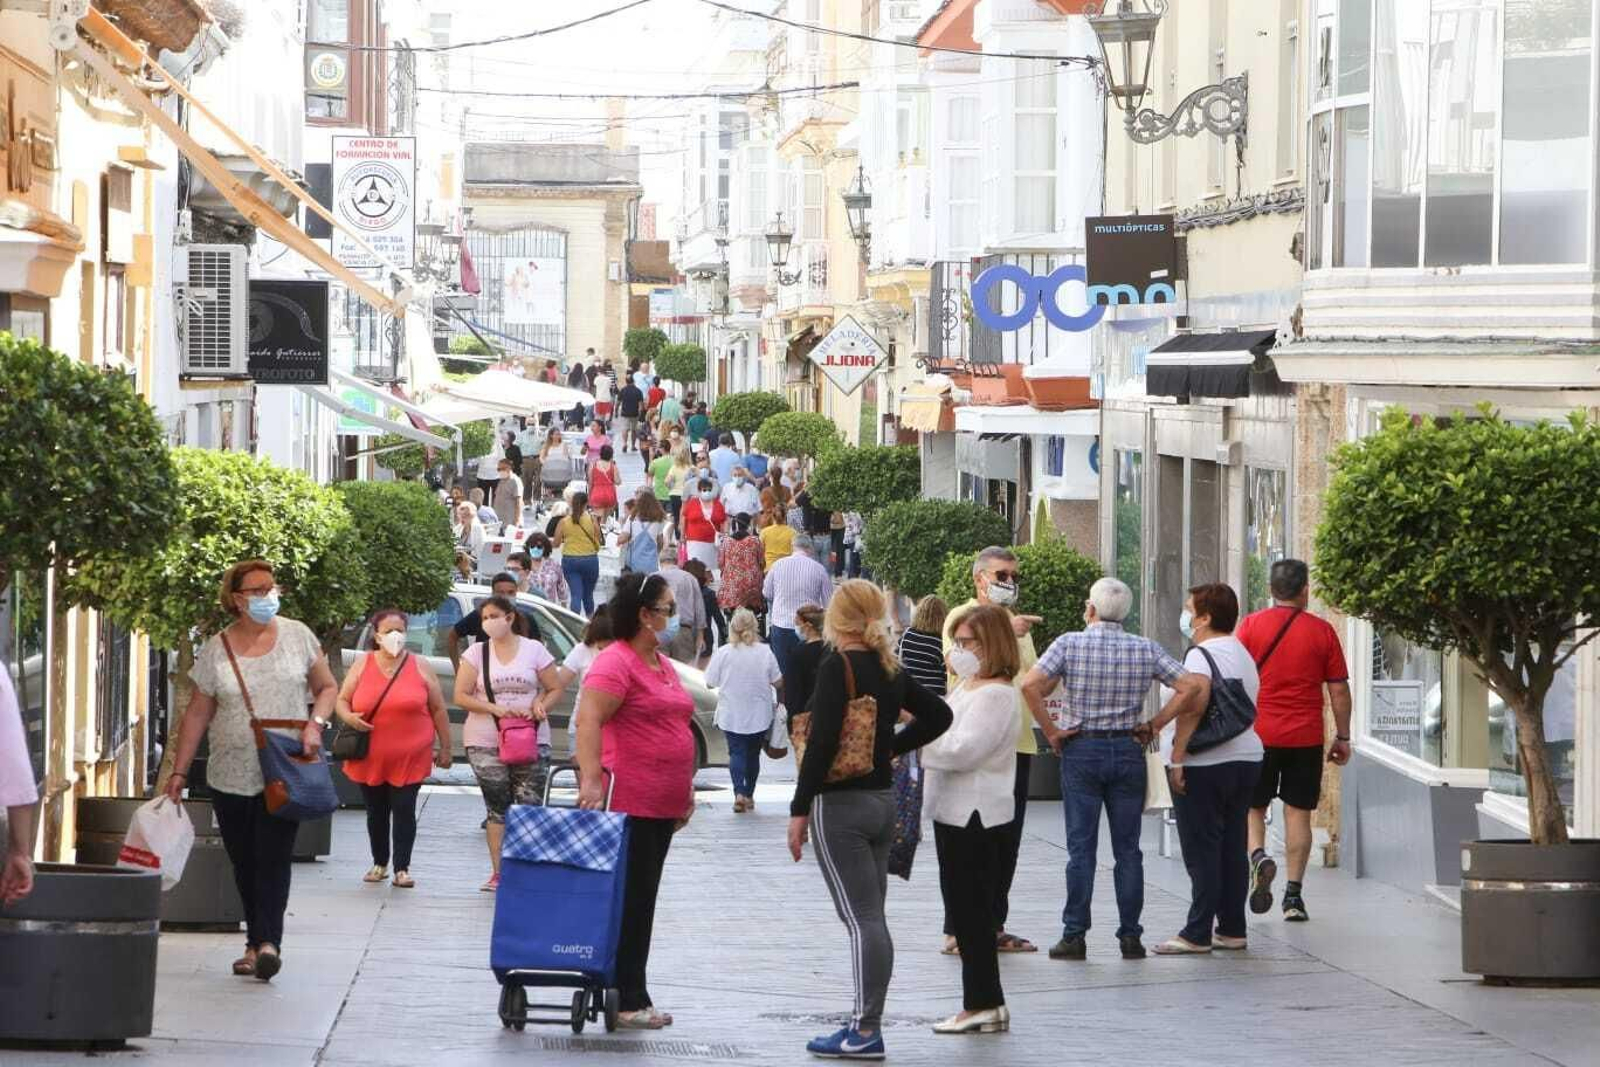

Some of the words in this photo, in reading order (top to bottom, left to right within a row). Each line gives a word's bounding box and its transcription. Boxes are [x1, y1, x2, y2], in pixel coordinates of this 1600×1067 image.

[349, 140, 384, 148] CENTRO
[386, 141, 399, 149] DE
[821, 355, 876, 366] JIJONA
